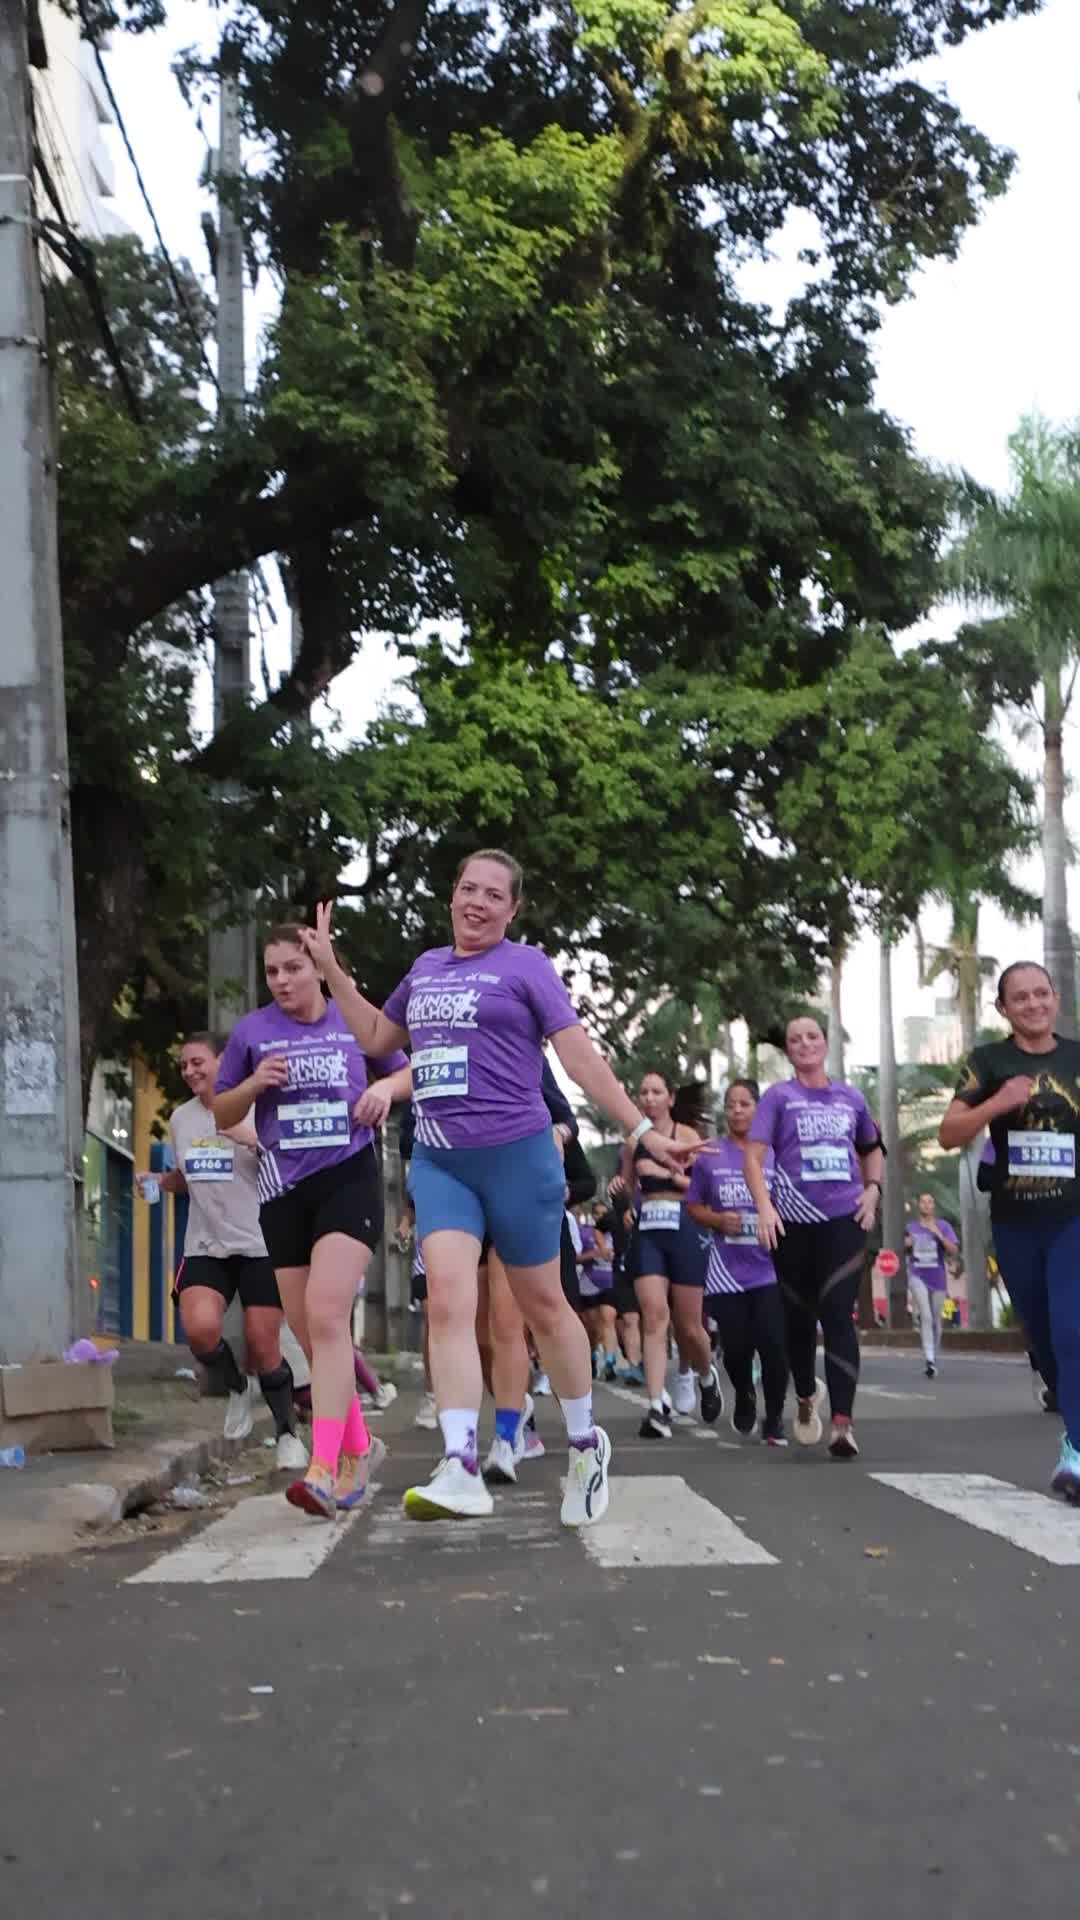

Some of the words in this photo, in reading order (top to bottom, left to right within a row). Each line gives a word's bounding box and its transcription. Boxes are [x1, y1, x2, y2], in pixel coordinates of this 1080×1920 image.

[409, 993, 466, 1010] MUNDO
[406, 1005, 465, 1023] MELHOR
[417, 1064, 450, 1083] 5124
[293, 1118, 333, 1134] 5438
[1021, 1146, 1061, 1163] 5328
[193, 1159, 222, 1169] 6466
